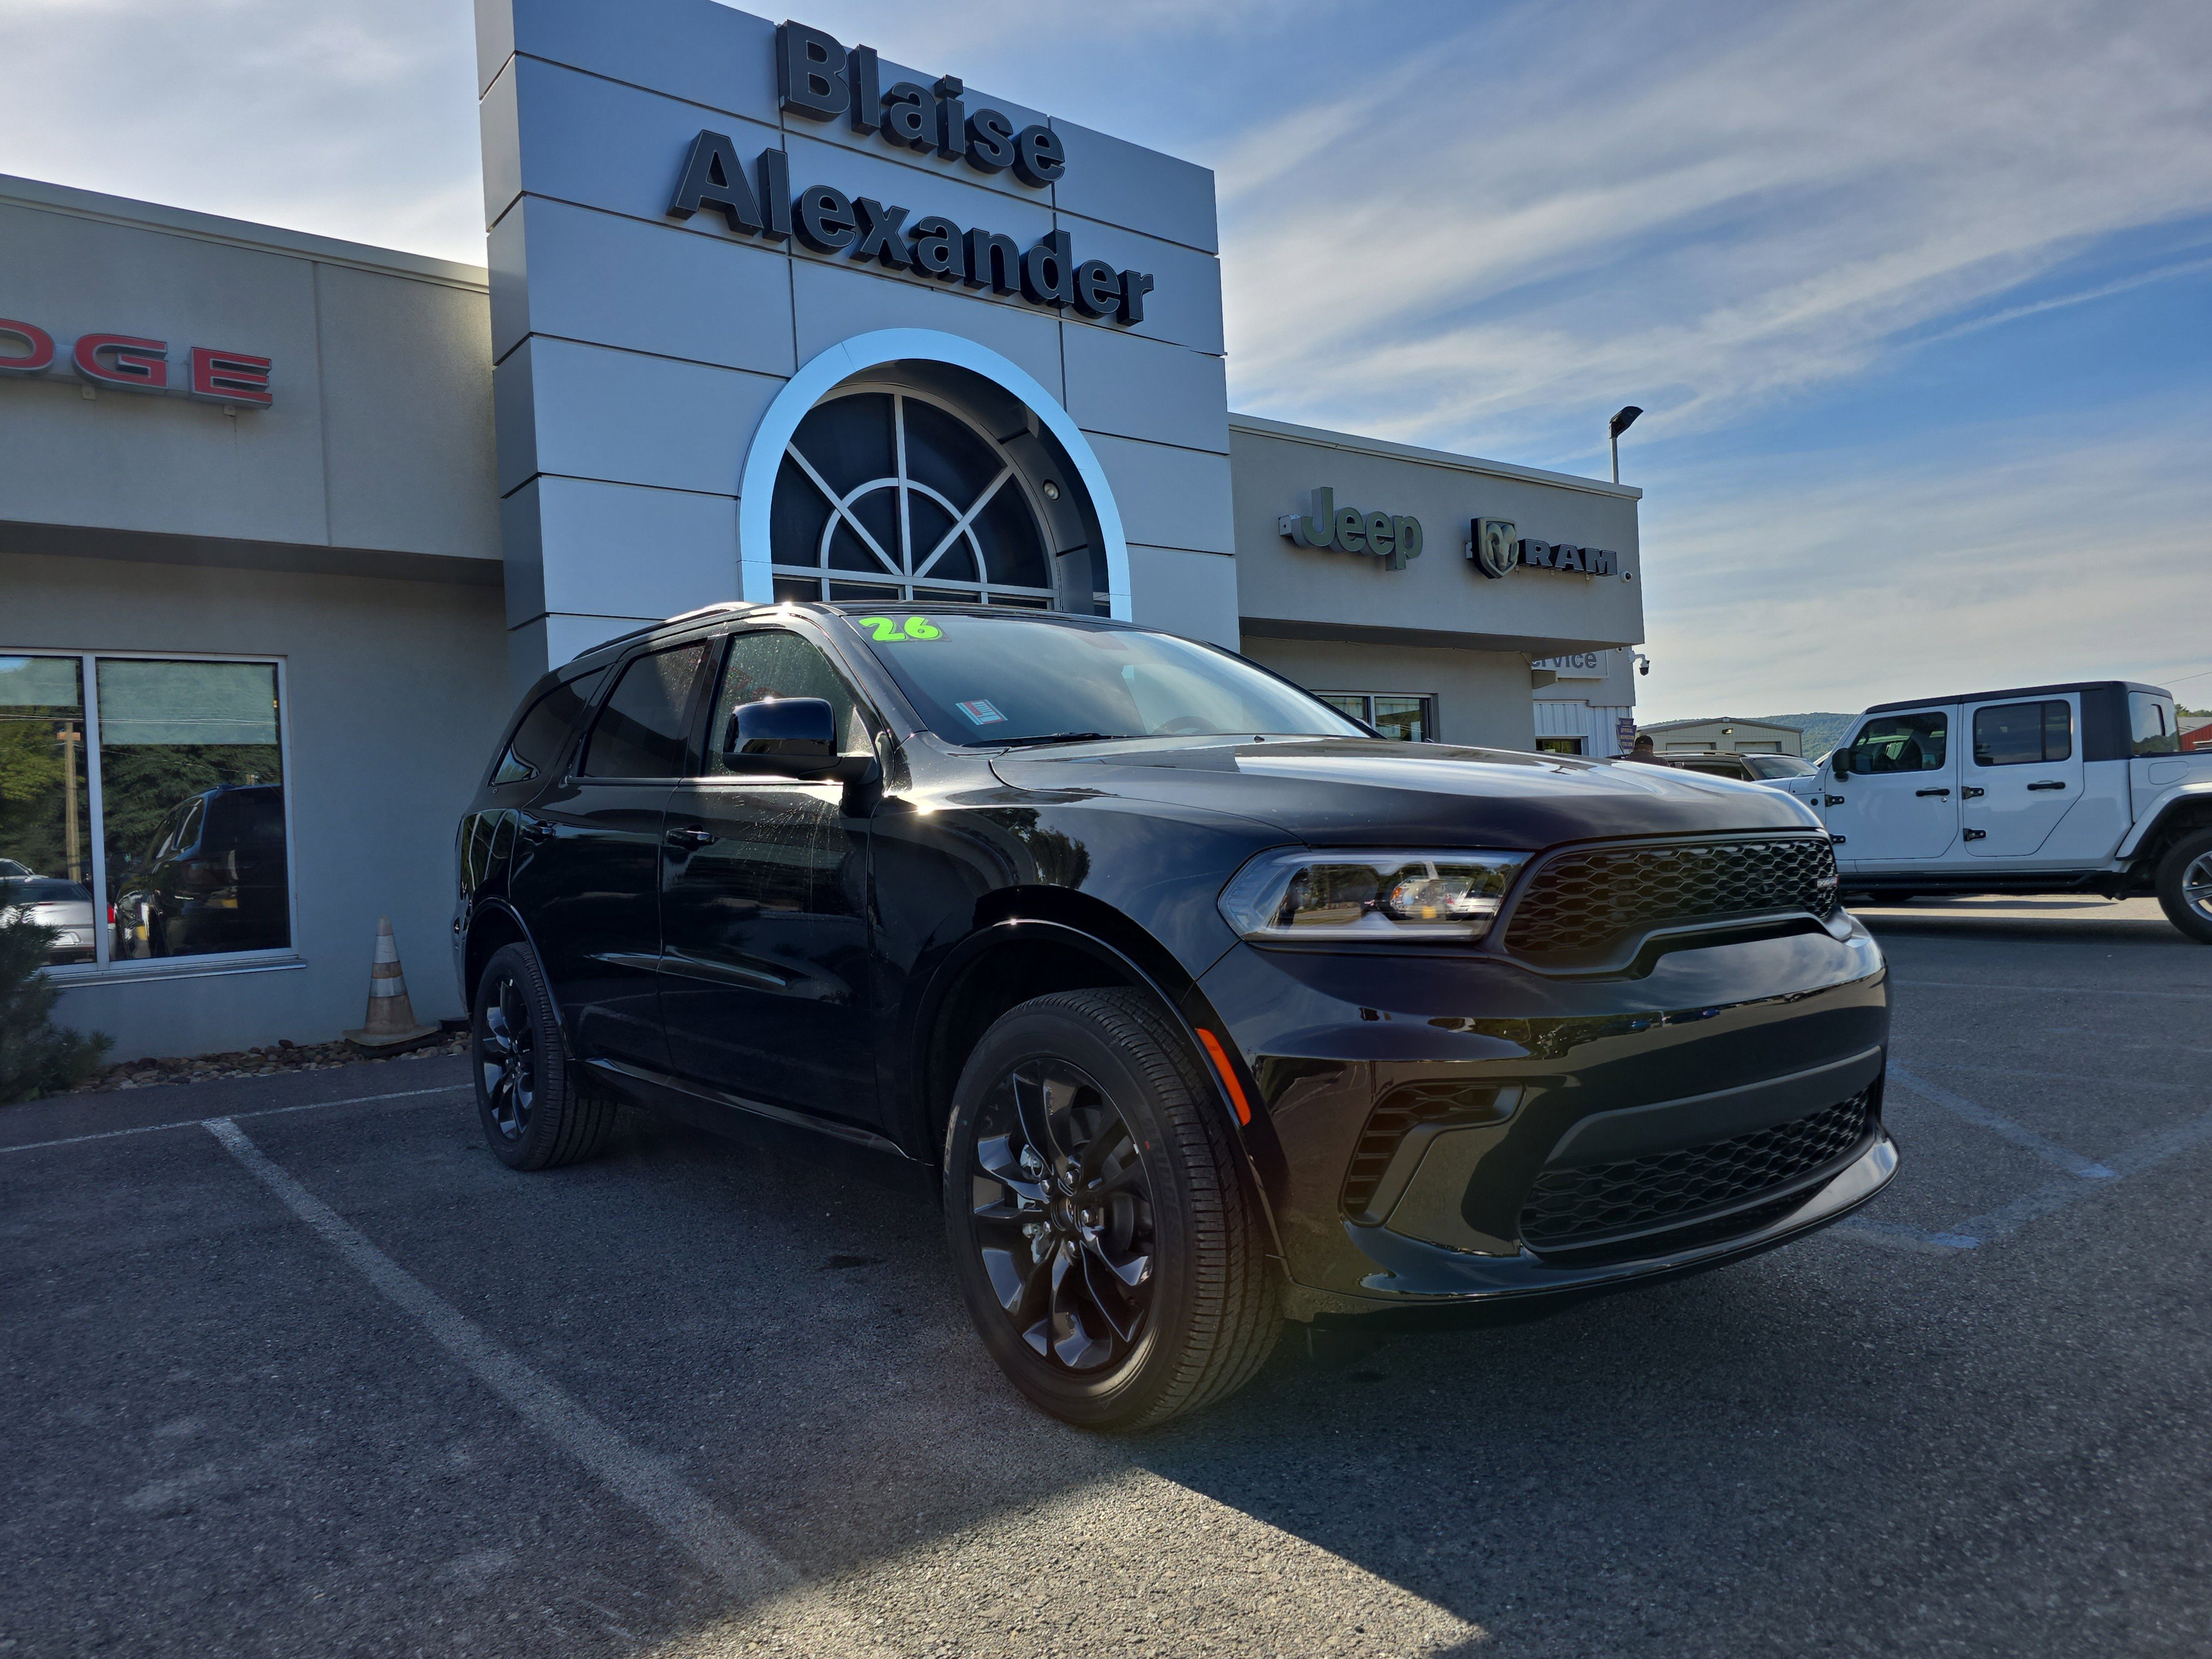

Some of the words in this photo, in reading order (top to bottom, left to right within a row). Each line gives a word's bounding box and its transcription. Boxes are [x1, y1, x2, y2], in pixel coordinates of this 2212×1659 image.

[776, 19, 1065, 189] Blaise
[666, 129, 1154, 326] Alexander
[1291, 486, 1423, 571] Jeep
[1518, 538, 1618, 576] RAM
[859, 616, 943, 641] 26
